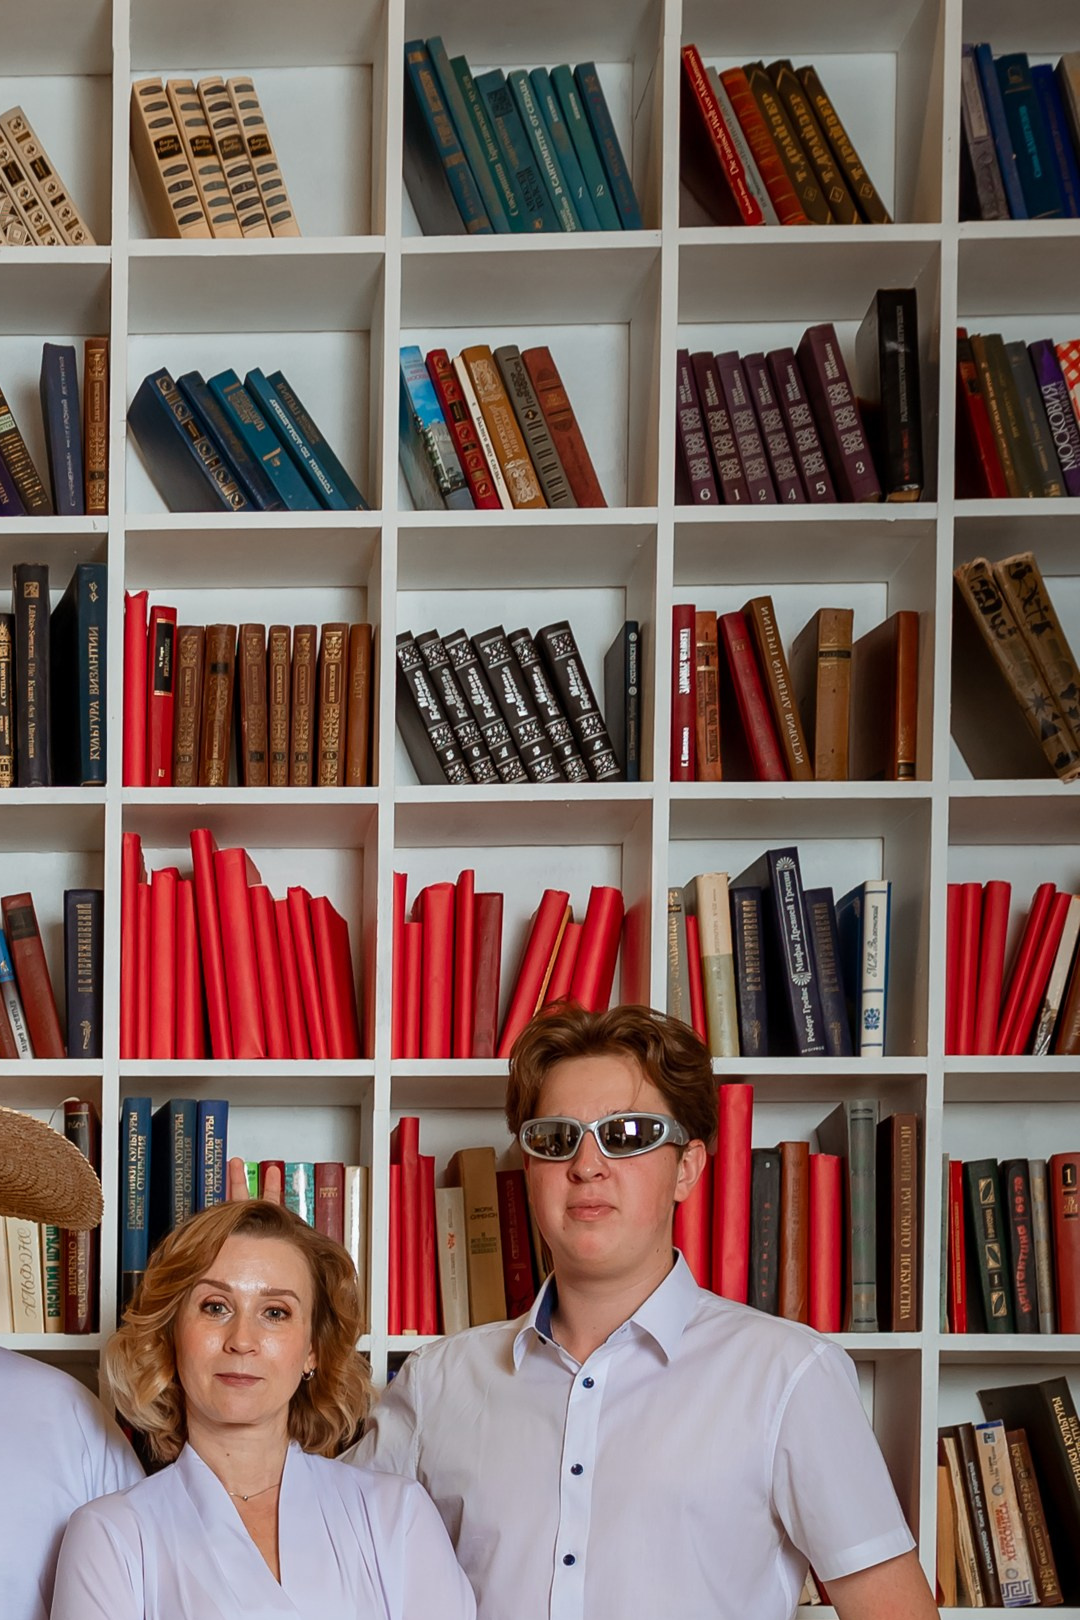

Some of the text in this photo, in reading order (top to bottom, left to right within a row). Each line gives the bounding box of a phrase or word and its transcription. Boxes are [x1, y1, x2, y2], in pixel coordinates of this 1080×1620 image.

[1041, 381, 1078, 471] МОСКОВИЯ
[816, 481, 826, 495] 5
[855, 461, 865, 475] 3
[700, 489, 710, 501] 6
[734, 489, 741, 501] 1
[758, 489, 766, 500] 2
[787, 488, 796, 500] 4
[88, 626, 100, 760] КУЛЬТУРА ВИЗАНТИИ
[759, 605, 804, 764] ИСТОРИЯ ДРЕВНЕЙ ГРЕЦИИ
[781, 870, 805, 972] Мифы Древней Греции
[803, 1015, 815, 1042] Роберт
[173, 1113, 184, 1163] КУЛЬТУРЫ
[204, 1115, 214, 1165] КУЛЬТУРЫ
[127, 1111, 137, 1229] ПАМЯТНИКИ КУЛЬТУРЫ
[136, 1135, 146, 1229] НОВЫЕ ОТКРЫТИЯ
[182, 1137, 193, 1192] ОТКРЫТИЯ
[213, 1137, 223, 1192] ОТКРЫТИЯ
[1063, 1166, 1072, 1184] 1
[899, 1126, 912, 1319] ИСТОРИЯ РУССКОГО ИСКУССТВА
[45, 1265, 60, 1316] ВАСИЛИЙ
[1050, 1396, 1074, 1446] КУЛЬТУРЫ
